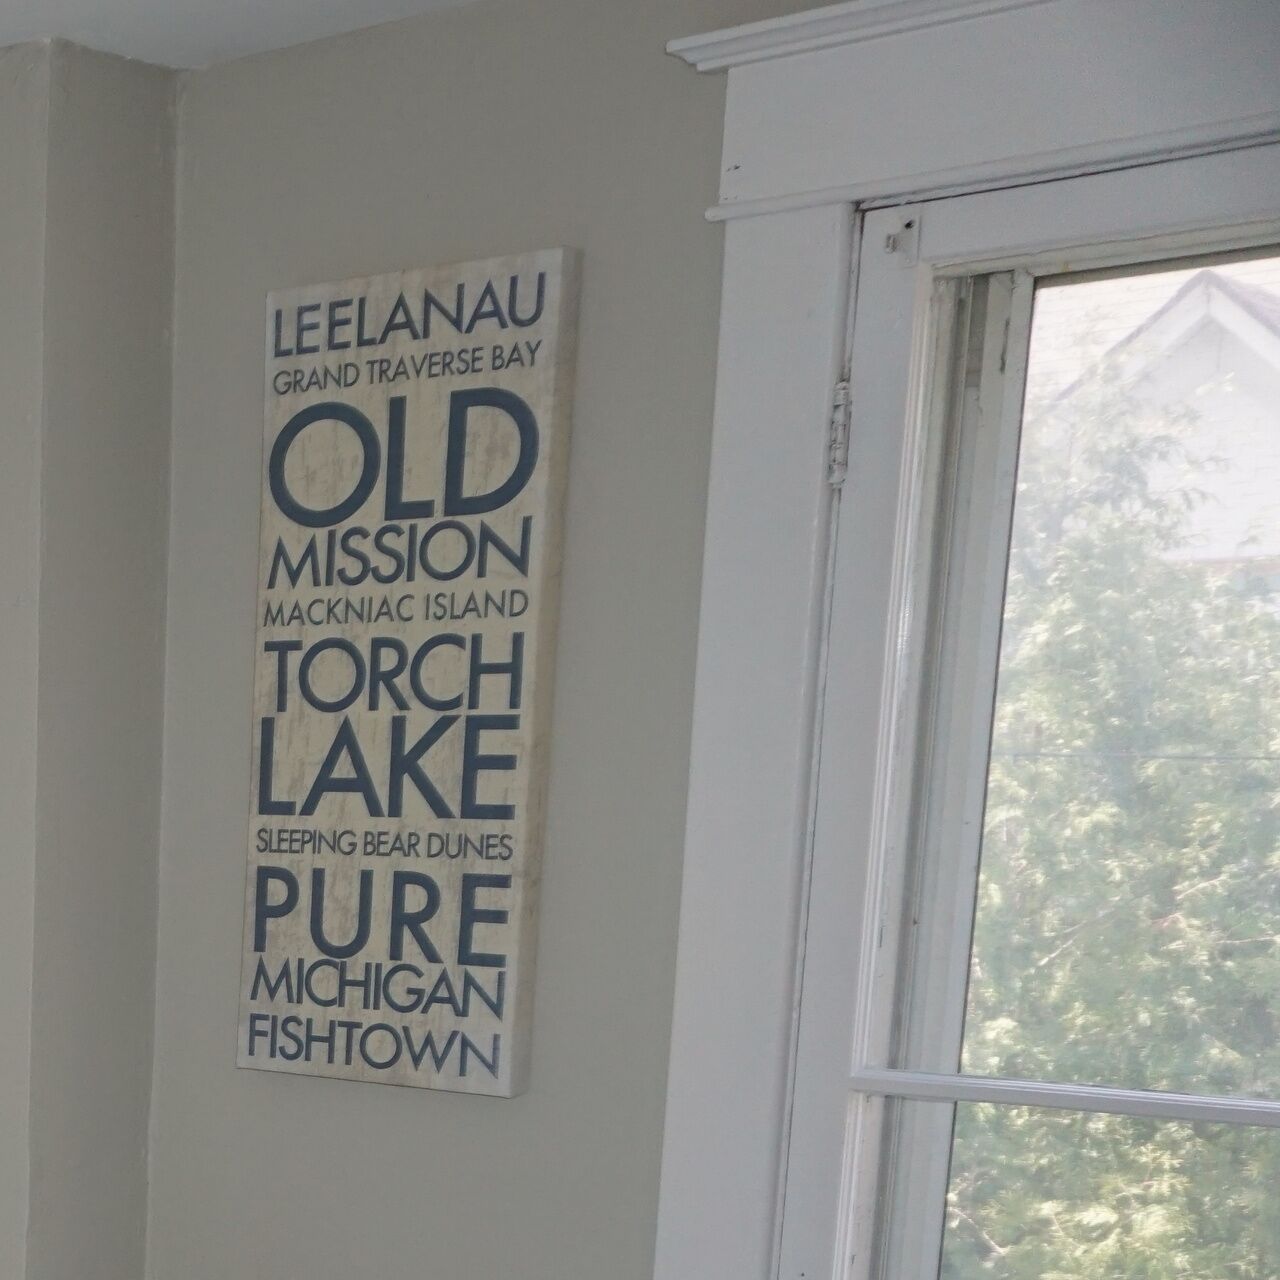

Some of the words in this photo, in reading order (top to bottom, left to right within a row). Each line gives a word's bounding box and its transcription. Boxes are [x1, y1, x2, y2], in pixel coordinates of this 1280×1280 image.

[273, 272, 547, 358] LEELANAU
[273, 362, 360, 395] GRAND
[366, 346, 484, 385] TRAVERSE
[492, 340, 542, 371] BAY
[269, 387, 540, 528] OLD
[267, 516, 533, 589] MISSION
[262, 594, 415, 627] MACKNIAC
[424, 589, 529, 622] ISLAND
[264, 632, 525, 713] TORCH
[258, 714, 520, 820] LAKE
[256, 828, 357, 856] SLEEPING
[363, 830, 421, 858] BEAR
[426, 832, 514, 861] DUNES
[253, 866, 512, 968] PURE
[250, 956, 507, 1022] MICHIGAN
[248, 1013, 501, 1079] FISHTOWN
